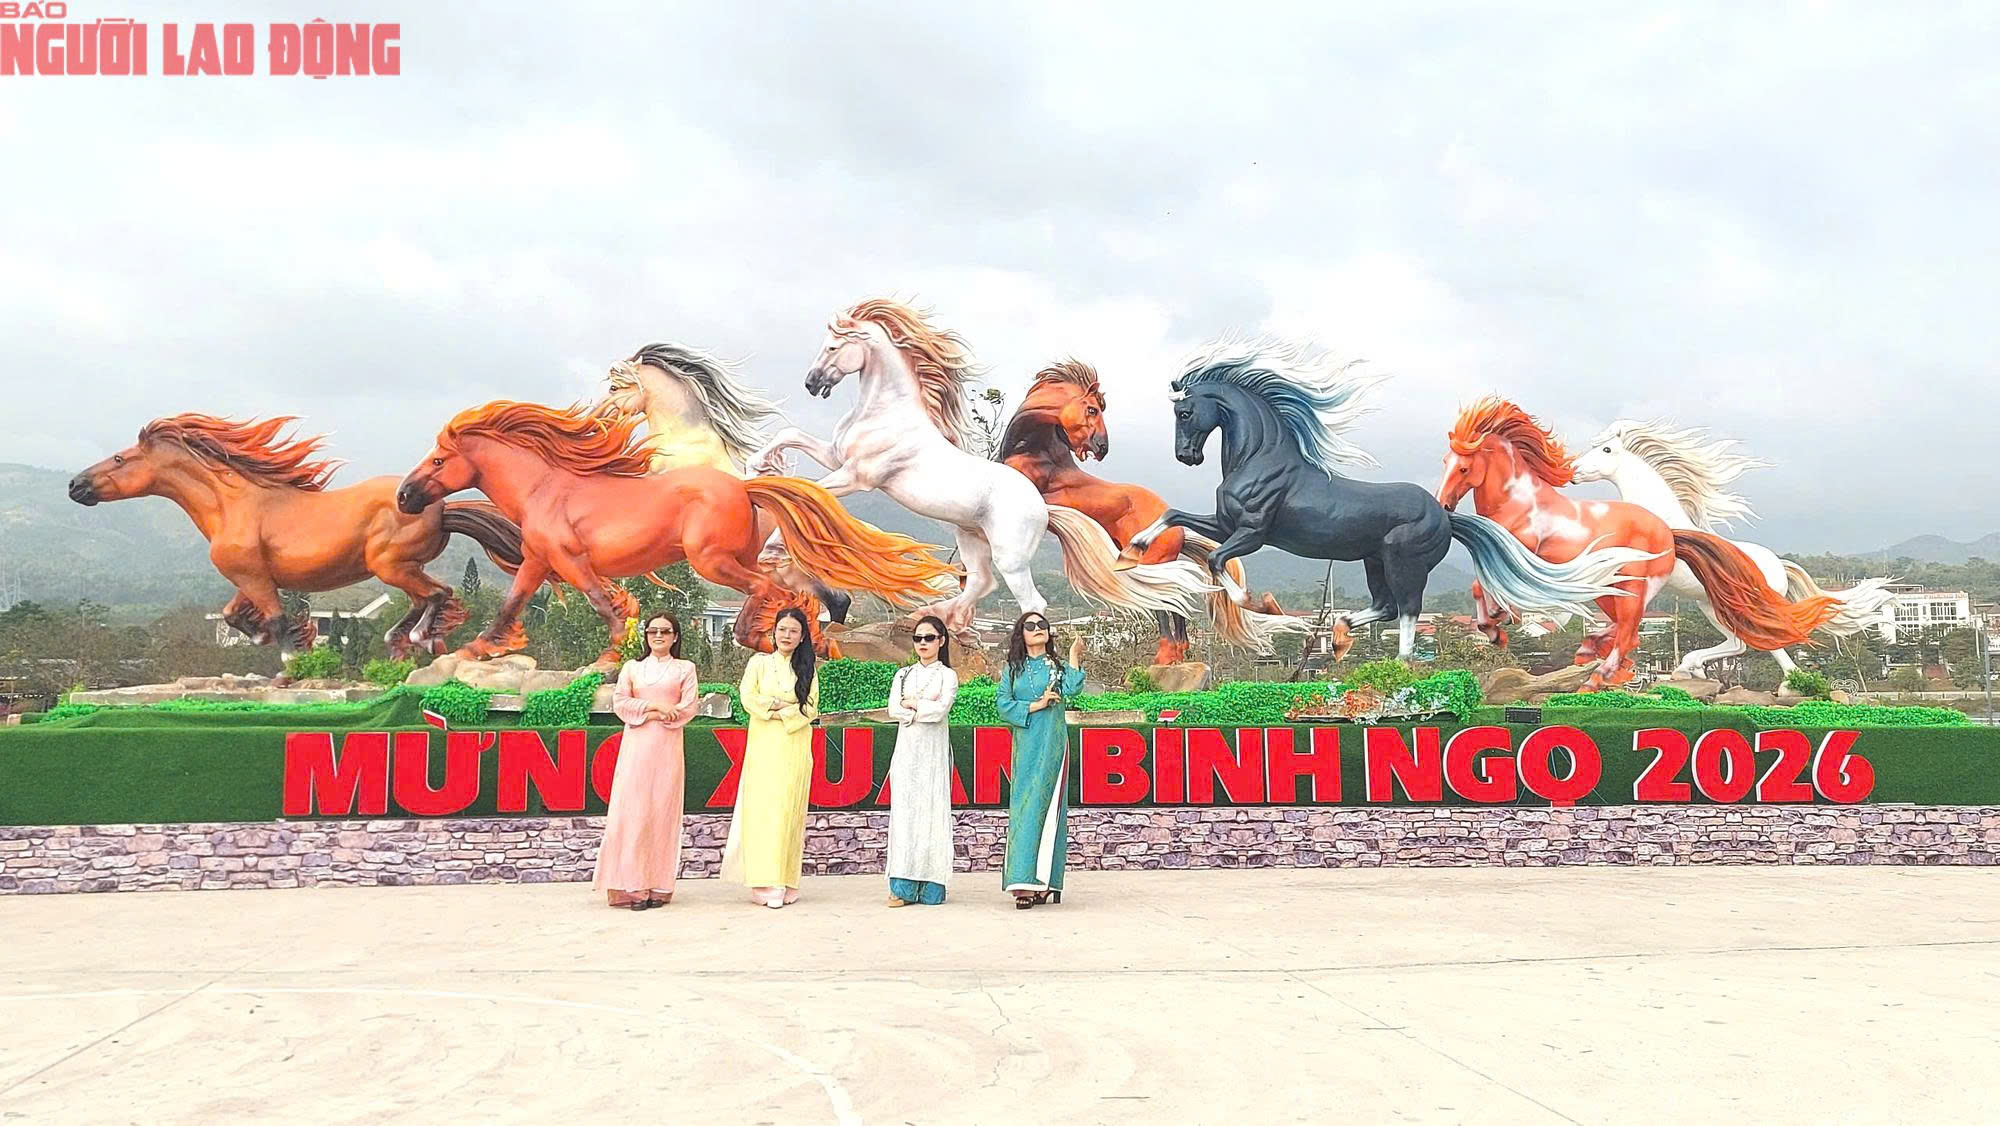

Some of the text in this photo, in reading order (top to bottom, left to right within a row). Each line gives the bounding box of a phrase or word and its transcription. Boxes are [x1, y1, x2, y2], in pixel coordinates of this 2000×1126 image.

[704, 727, 1013, 808] UN
[1080, 710, 1343, 805] BÍNH
[1363, 724, 1602, 807] NGỌ
[1633, 727, 1876, 804] 2026
